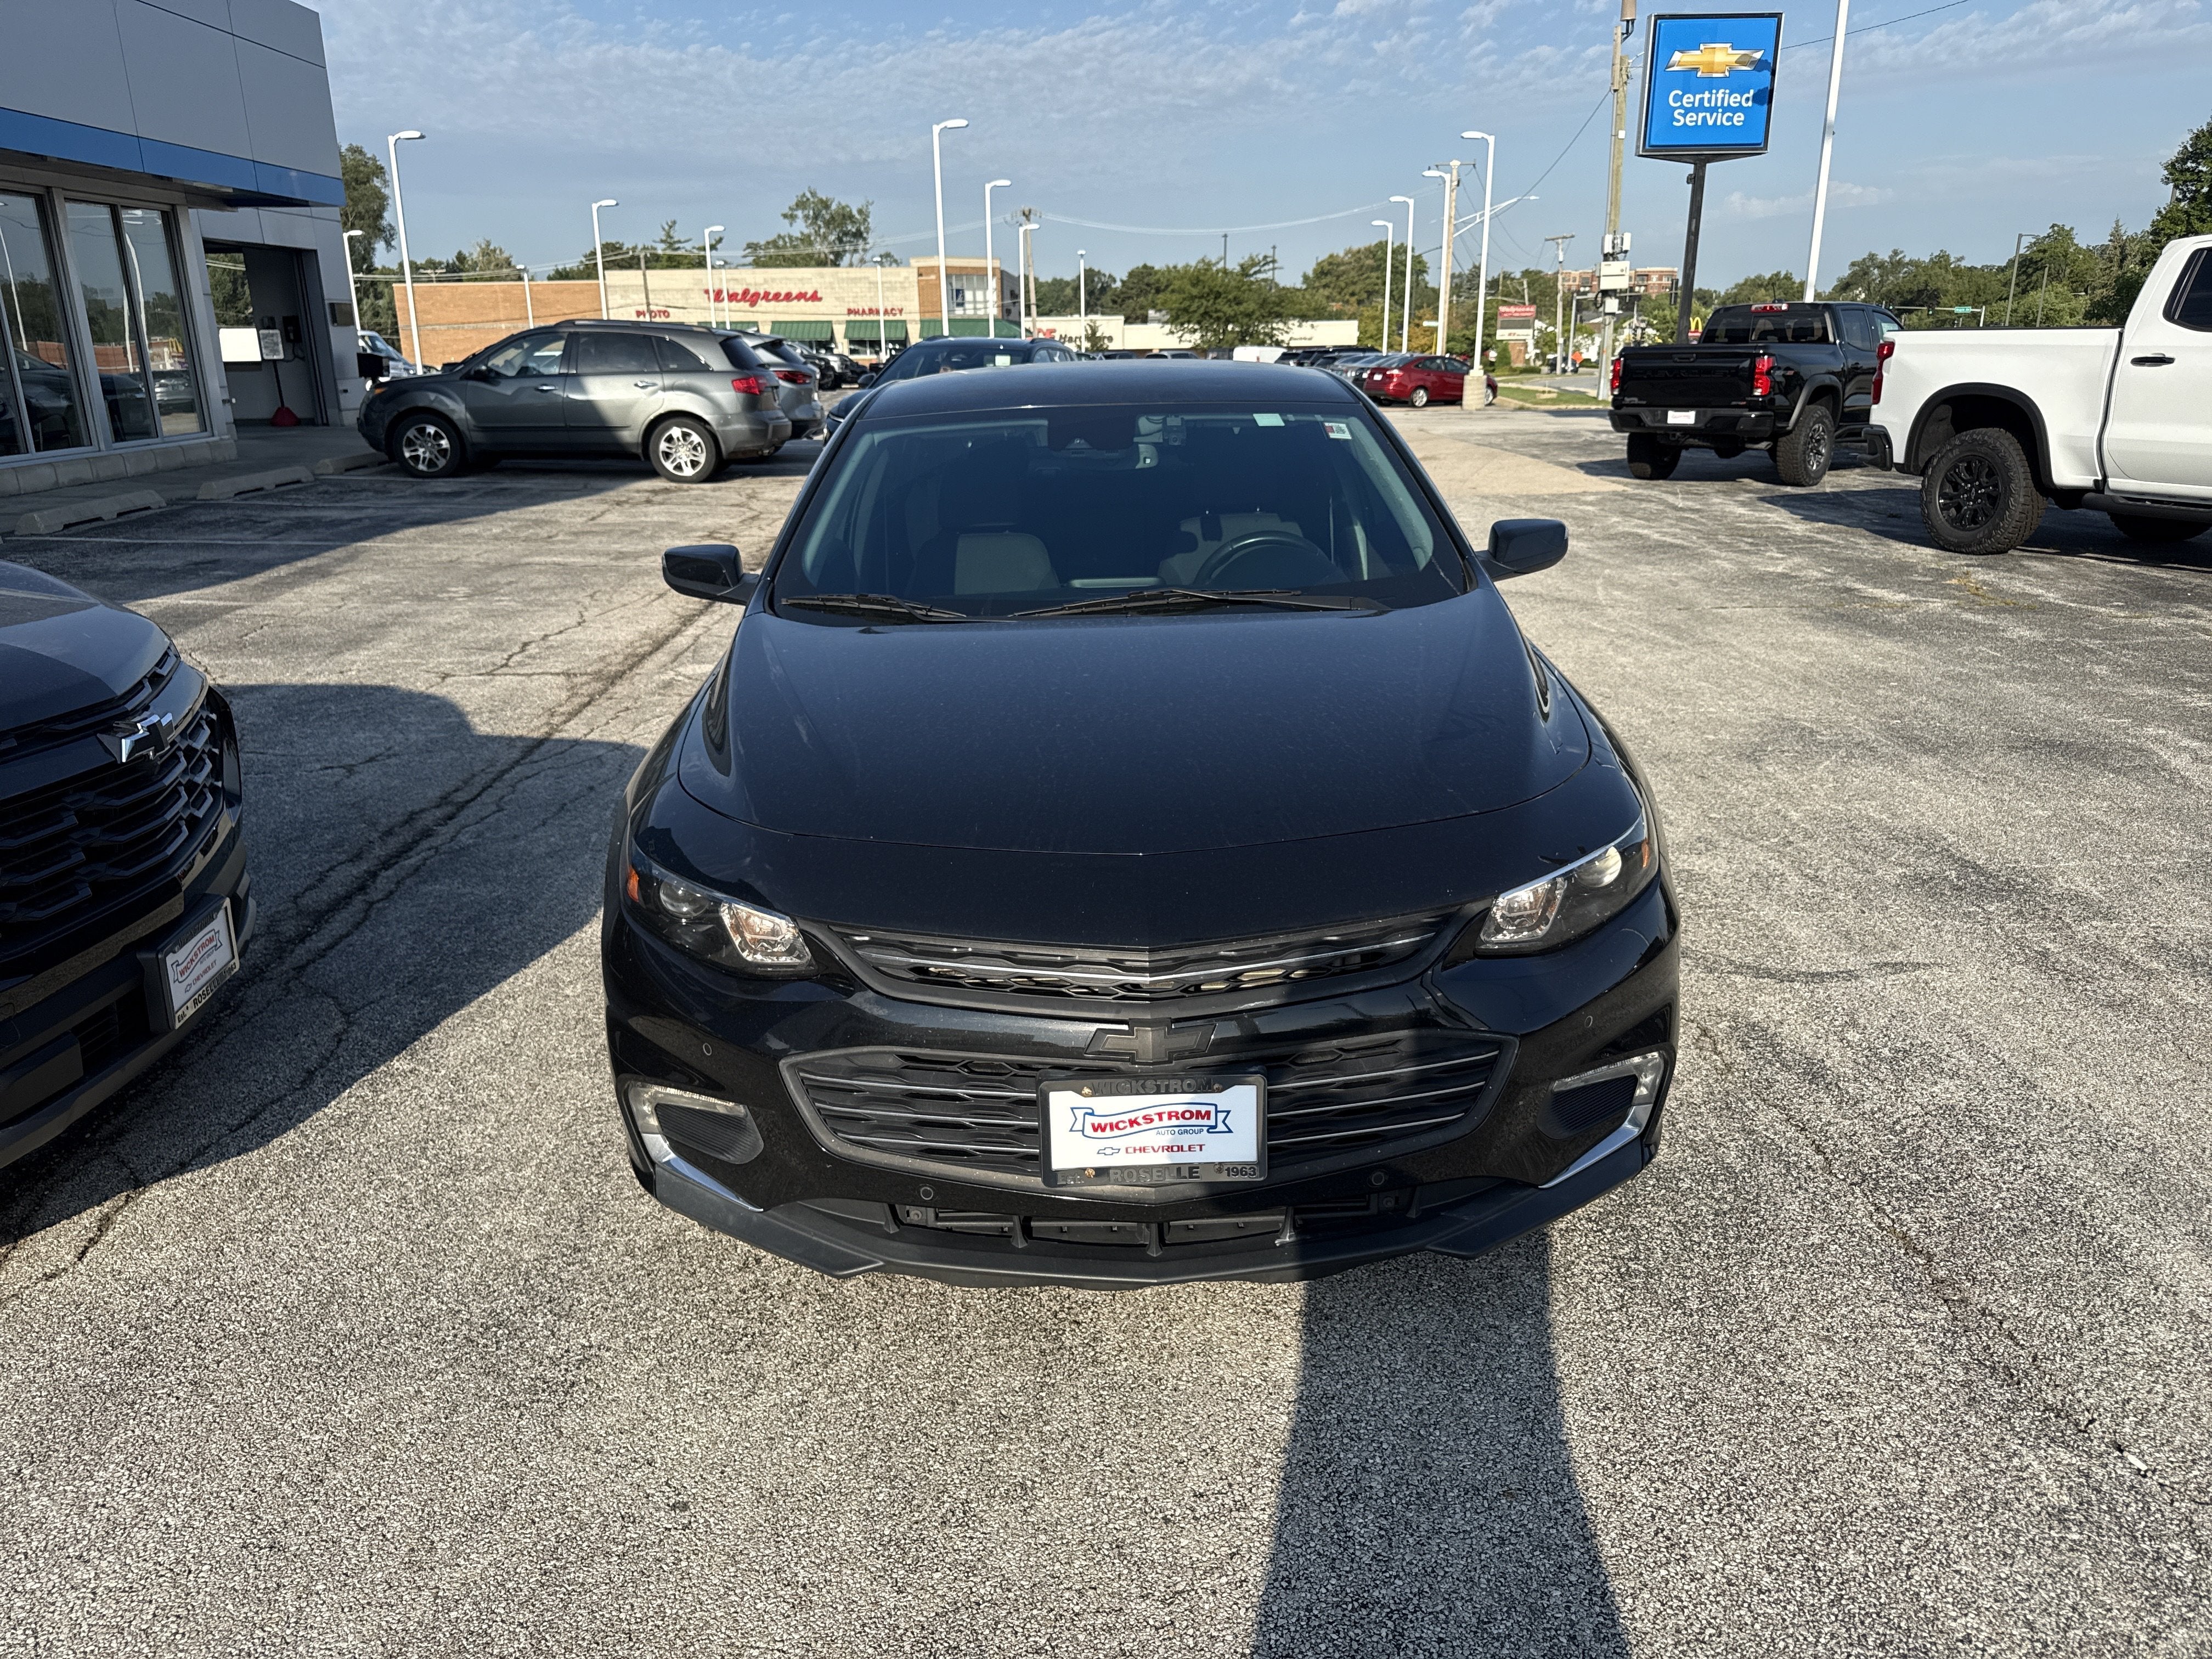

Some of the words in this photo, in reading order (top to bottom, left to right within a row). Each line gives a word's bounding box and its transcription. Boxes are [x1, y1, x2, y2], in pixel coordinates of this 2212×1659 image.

[1669, 89, 1754, 107] Certified
[1673, 109, 1744, 126] Service
[704, 288, 822, 307] Walgreens
[179, 934, 215, 977] WICKSTROM
[193, 960, 216, 985] CHEVROLET
[193, 977, 220, 1008] ROSELLE
[1091, 1077, 1212, 1094] WICKSTROM
[1091, 1110, 1211, 1132] WICKSTROM
[1125, 1144, 1206, 1154] CHEVROLET
[1109, 1166, 1200, 1182] ROSELLE
[1225, 1166, 1257, 1177] 1963
